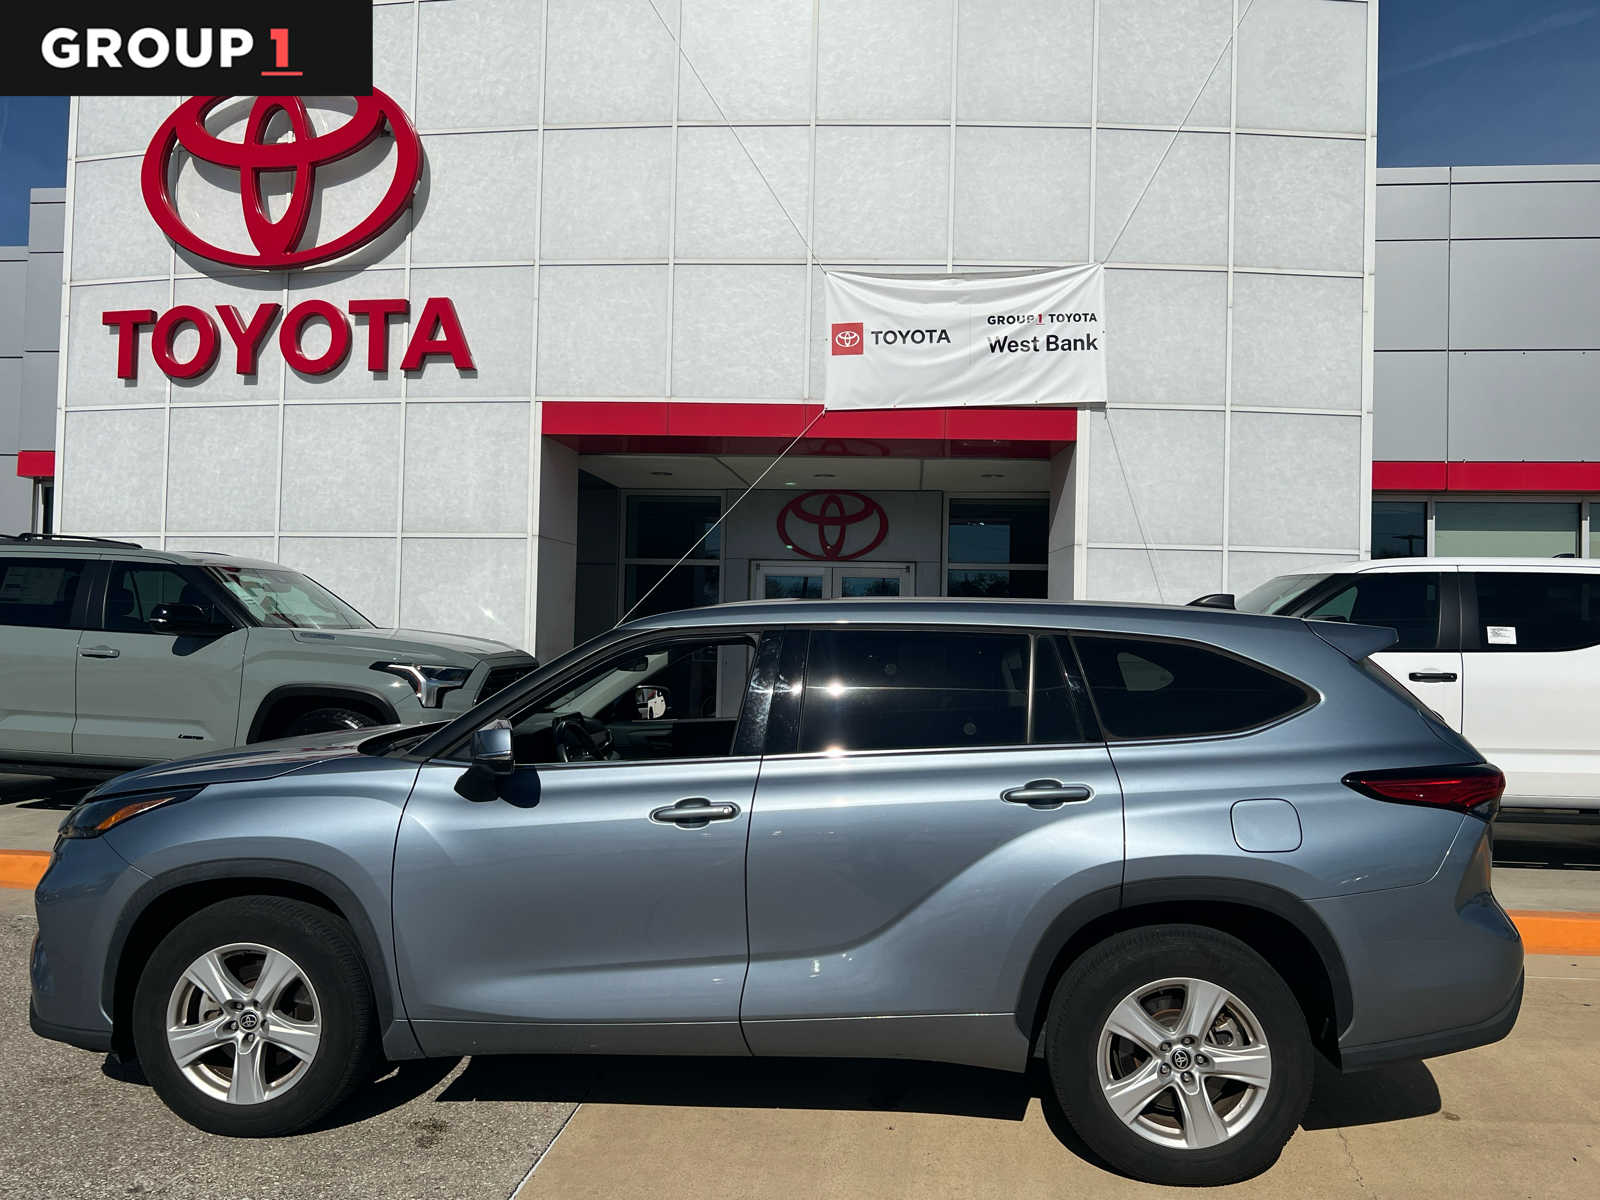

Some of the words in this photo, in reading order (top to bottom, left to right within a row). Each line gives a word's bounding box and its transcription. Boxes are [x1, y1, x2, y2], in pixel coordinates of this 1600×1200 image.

[987, 315, 1034, 325] GROUP
[1048, 313, 1098, 323] TOYOTA
[102, 297, 476, 380] TOYOTA
[870, 329, 951, 345] TOYOTA
[987, 335, 1040, 354] West
[1046, 333, 1098, 352] Bank
